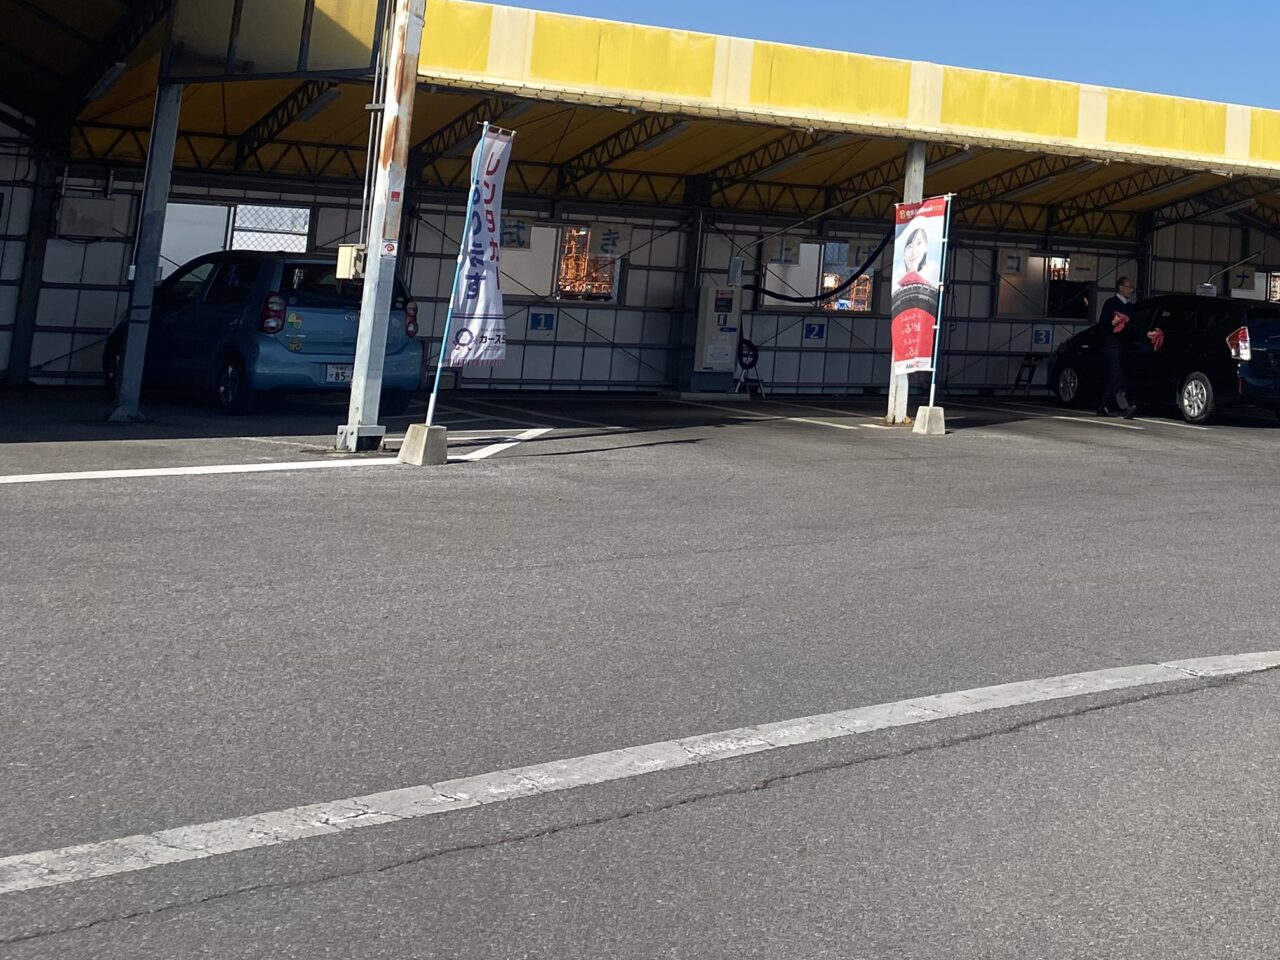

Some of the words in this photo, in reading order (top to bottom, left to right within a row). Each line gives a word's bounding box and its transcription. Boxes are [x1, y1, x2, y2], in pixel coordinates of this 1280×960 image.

[483, 152, 500, 290] レンタカー
[601, 228, 620, 253] き
[537, 314, 546, 329] 1
[810, 324, 820, 339] 2
[1038, 330, 1047, 344] 3
